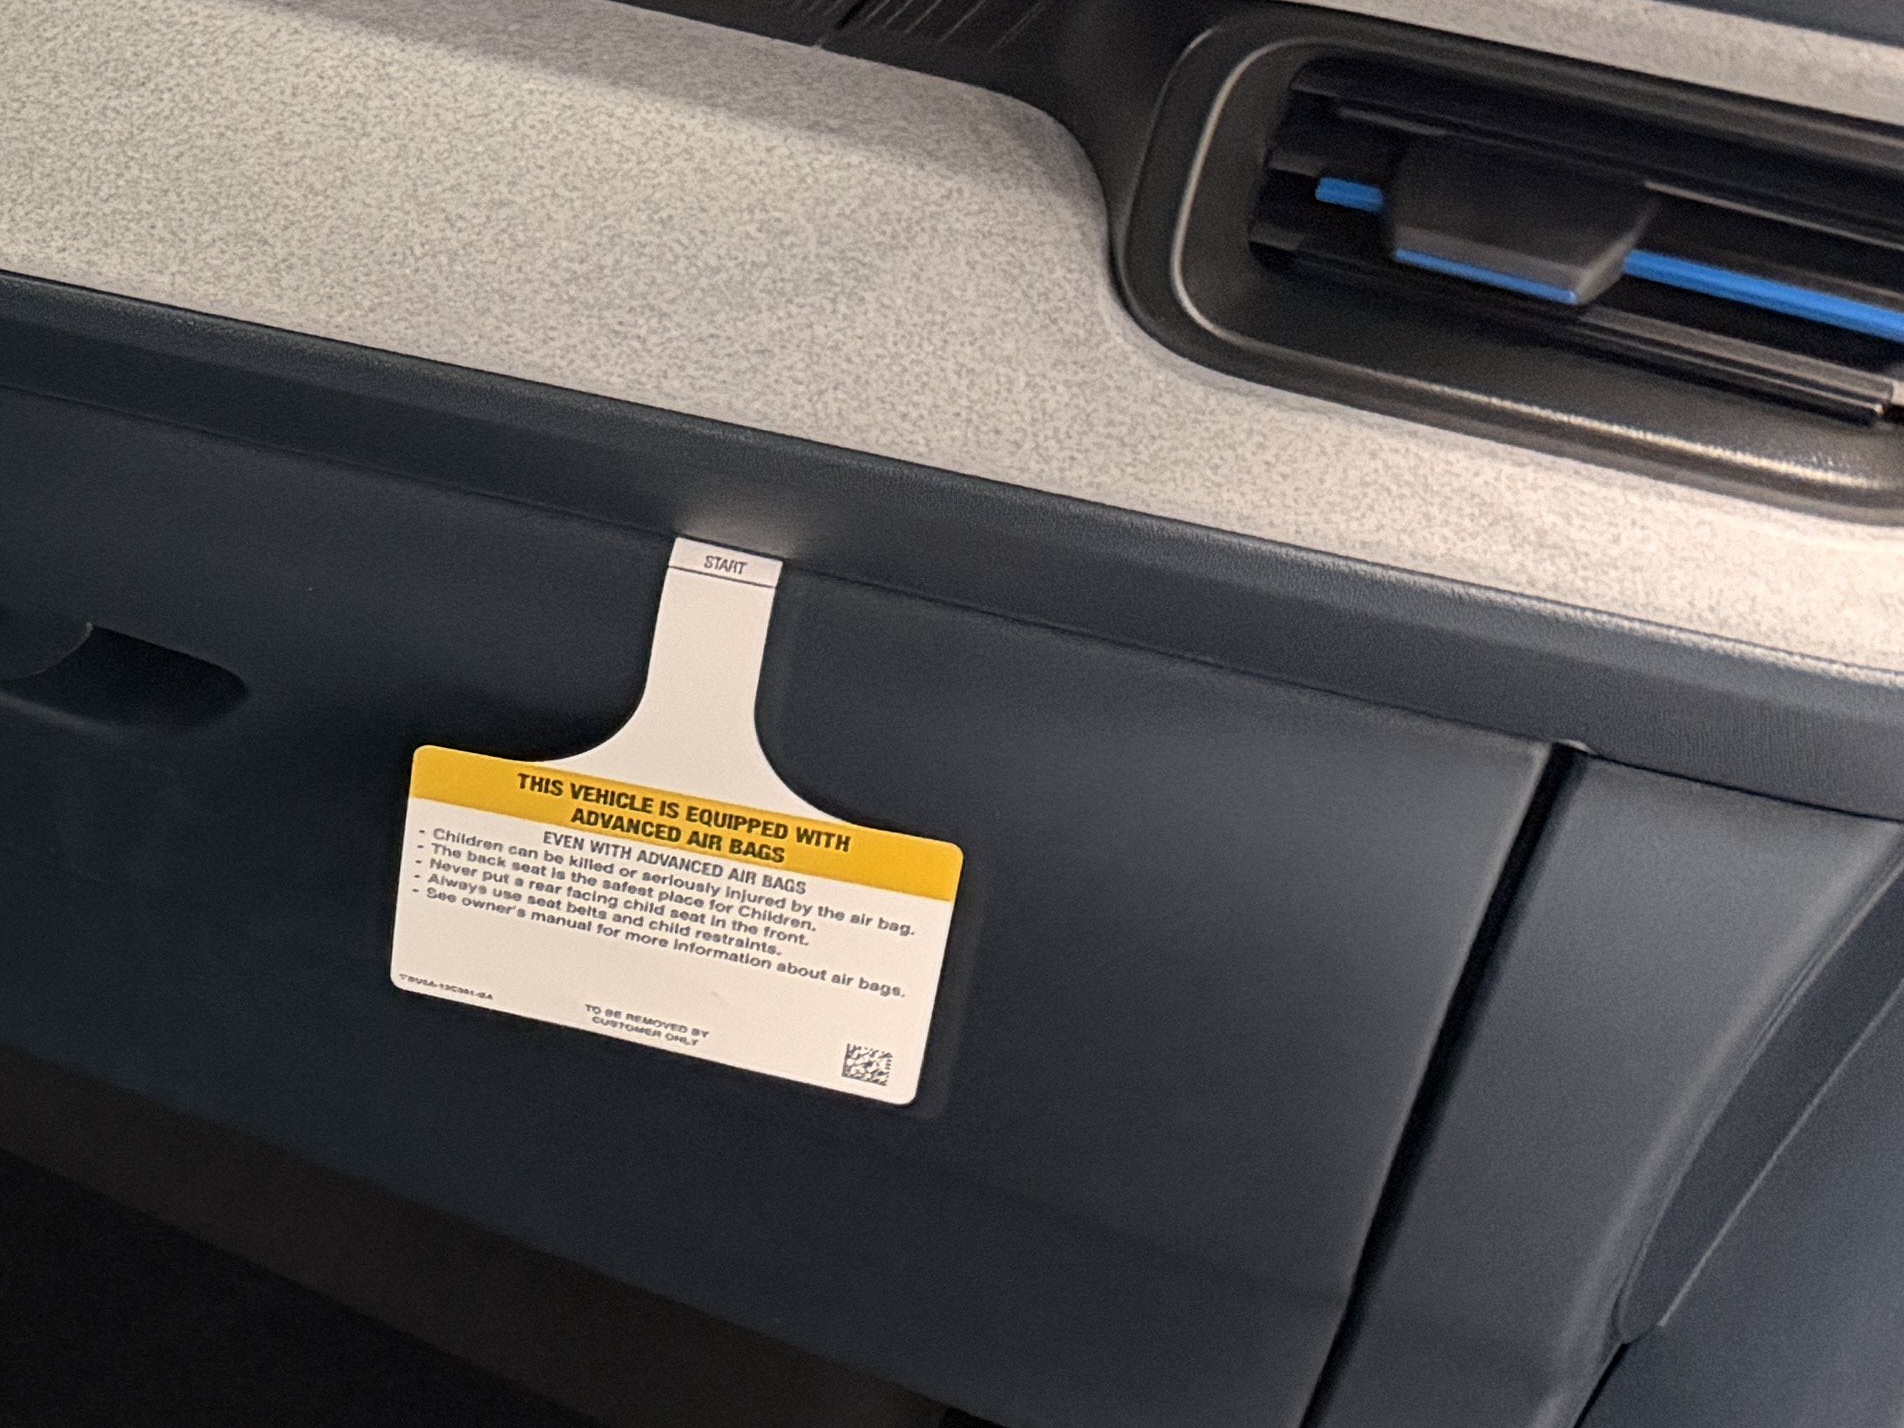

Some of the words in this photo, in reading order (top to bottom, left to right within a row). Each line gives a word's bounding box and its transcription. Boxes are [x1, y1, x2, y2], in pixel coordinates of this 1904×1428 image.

[704, 555, 747, 574] START
[517, 772, 563, 797] THIS
[570, 783, 653, 814] VEHICLE
[660, 800, 679, 819] IS
[686, 806, 788, 839] EQUIPPED
[795, 826, 851, 852] WITH
[570, 808, 681, 843] ADVANCED
[688, 830, 722, 851] AIR
[729, 839, 785, 863] BAGS
[429, 858, 478, 879] Never
[482, 871, 509, 885] put
[515, 877, 524, 888] a
[528, 880, 562, 896] rear
[567, 886, 618, 909] facing
[623, 897, 665, 917] child
[670, 909, 705, 924] seat
[711, 915, 726, 929] in
[732, 919, 758, 935] the
[764, 927, 809, 946] front.
[431, 842, 462, 859] The
[467, 851, 506, 868] back
[512, 862, 547, 877] seat
[552, 867, 565, 880] is
[571, 871, 598, 887] the
[603, 877, 653, 899] safest
[659, 890, 704, 909] place
[709, 899, 733, 914] for
[738, 906, 817, 932] Children.
[433, 828, 503, 853] Children
[508, 845, 538, 860] can
[544, 849, 563, 865] be
[569, 855, 613, 875] killed
[619, 867, 637, 879] or
[642, 870, 720, 897] seriously
[726, 887, 786, 909] injured
[792, 900, 812, 917] by
[818, 906, 844, 922] the
[851, 912, 873, 927] air
[877, 917, 915, 937] bag.
[543, 831, 584, 851] EVEN
[590, 840, 632, 860] WITH
[636, 850, 723, 878] ADVANCED
[728, 868, 756, 885] AIR
[762, 875, 806, 895] BAGS
[426, 887, 457, 903] See
[462, 896, 526, 918] owner's
[531, 910, 592, 932] manual
[597, 923, 621, 938] for
[625, 930, 669, 948] more
[673, 934, 772, 970] information
[777, 961, 826, 982] about
[831, 972, 854, 986] air
[859, 977, 905, 997] bags.
[427, 873, 487, 895] Always
[493, 888, 522, 902] use
[527, 894, 561, 910] seat
[567, 901, 607, 920] belts
[613, 910, 644, 927] and
[649, 918, 690, 937] child
[695, 929, 783, 956] restraints.
[586, 1003, 602, 1015] TO
[605, 1008, 622, 1020] BE
[626, 1013, 688, 1035] REMOVED
[691, 1028, 709, 1039] BY
[592, 1016, 662, 1038] CUSTOMER
[665, 1033, 699, 1046] ONLY
